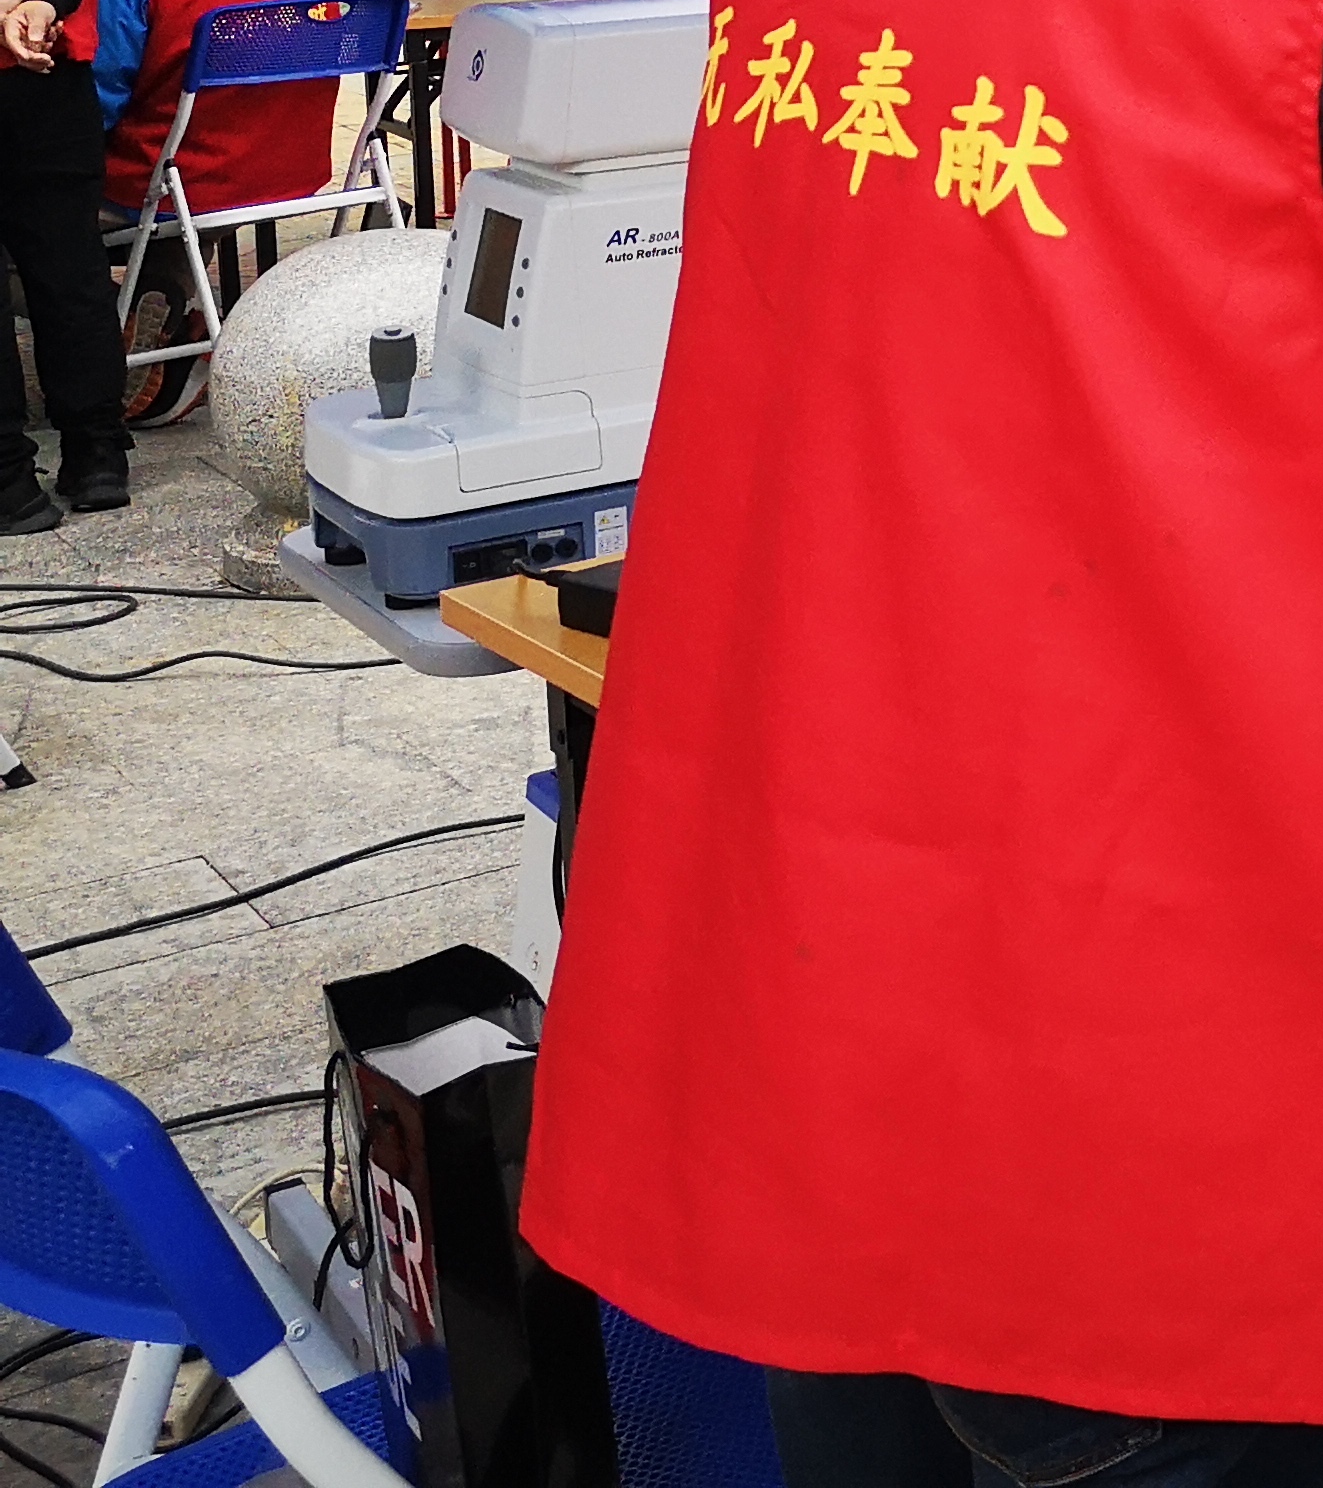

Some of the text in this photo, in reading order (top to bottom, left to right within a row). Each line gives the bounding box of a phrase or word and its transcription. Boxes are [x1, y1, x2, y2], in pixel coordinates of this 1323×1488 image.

[700, 5, 1070, 238] 无私奉献
[606, 228, 640, 248] AR
[605, 253, 634, 264] Auto
